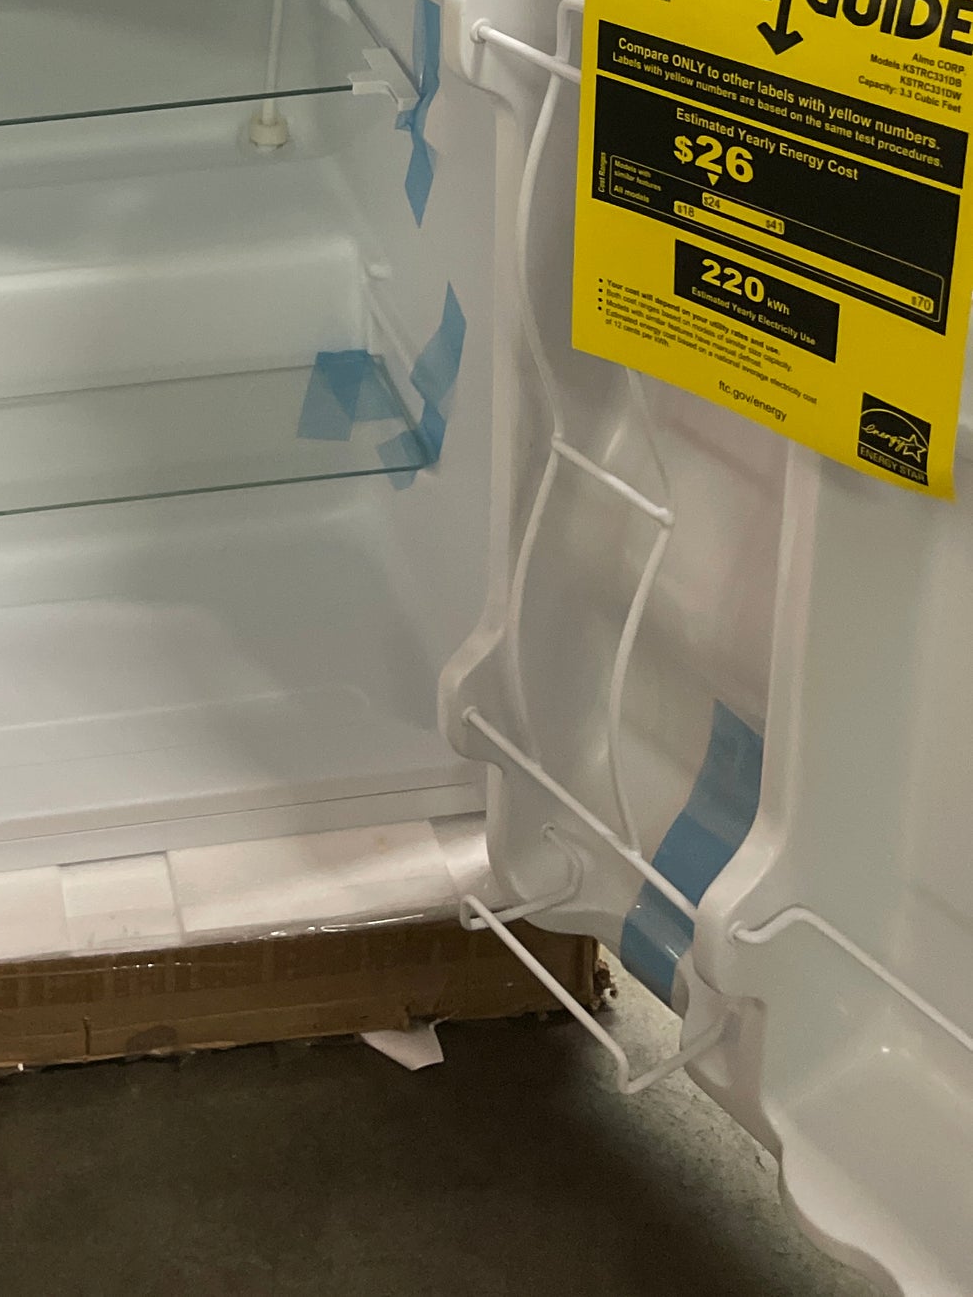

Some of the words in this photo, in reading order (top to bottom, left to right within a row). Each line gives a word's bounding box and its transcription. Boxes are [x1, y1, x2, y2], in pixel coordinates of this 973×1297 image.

[618, 37, 669, 63] Compare
[672, 54, 706, 75] ONLY
[707, 65, 719, 80] to
[722, 71, 755, 91] other
[757, 80, 795, 103] labels
[798, 95, 825, 114] with
[829, 105, 872, 128] yellow
[875, 119, 941, 150] numbers.
[858, 75, 897, 94] Capacity:
[899, 88, 913, 98] 3.3
[914, 92, 940, 107] Cubic
[942, 101, 962, 113] Feet
[900, 76, 963, 101] KSTRC331DW
[613, 51, 642, 70] Labels
[644, 62, 663, 76] with
[664, 70, 693, 87] yellow
[696, 79, 737, 101] numbers
[739, 94, 755, 107] are
[757, 97, 788, 117] based
[790, 111, 803, 123] on
[805, 114, 822, 128] the
[824, 122, 852, 139] same
[855, 131, 876, 146] test
[877, 139, 944, 168] procedures.
[673, 135, 754, 183] $26
[677, 107, 735, 138] Estimated
[738, 127, 776, 153] Yearly
[779, 142, 825, 169] Energy
[827, 159, 859, 180] Cost
[614, 185, 624, 195] All
[625, 189, 650, 203] models
[677, 204, 695, 218] $18
[704, 196, 721, 209] $24
[766, 218, 783, 233] $41
[701, 258, 765, 303] 220
[767, 297, 790, 316] kWh
[911, 295, 932, 311] $70
[691, 287, 730, 309] Estimated
[732, 304, 756, 321] Yearly
[758, 315, 799, 339] Electricity
[800, 331, 816, 346] Use
[718, 380, 787, 422] ftc.gov/energy
[860, 446, 899, 471] ENERGY
[899, 465, 926, 482] STAR
